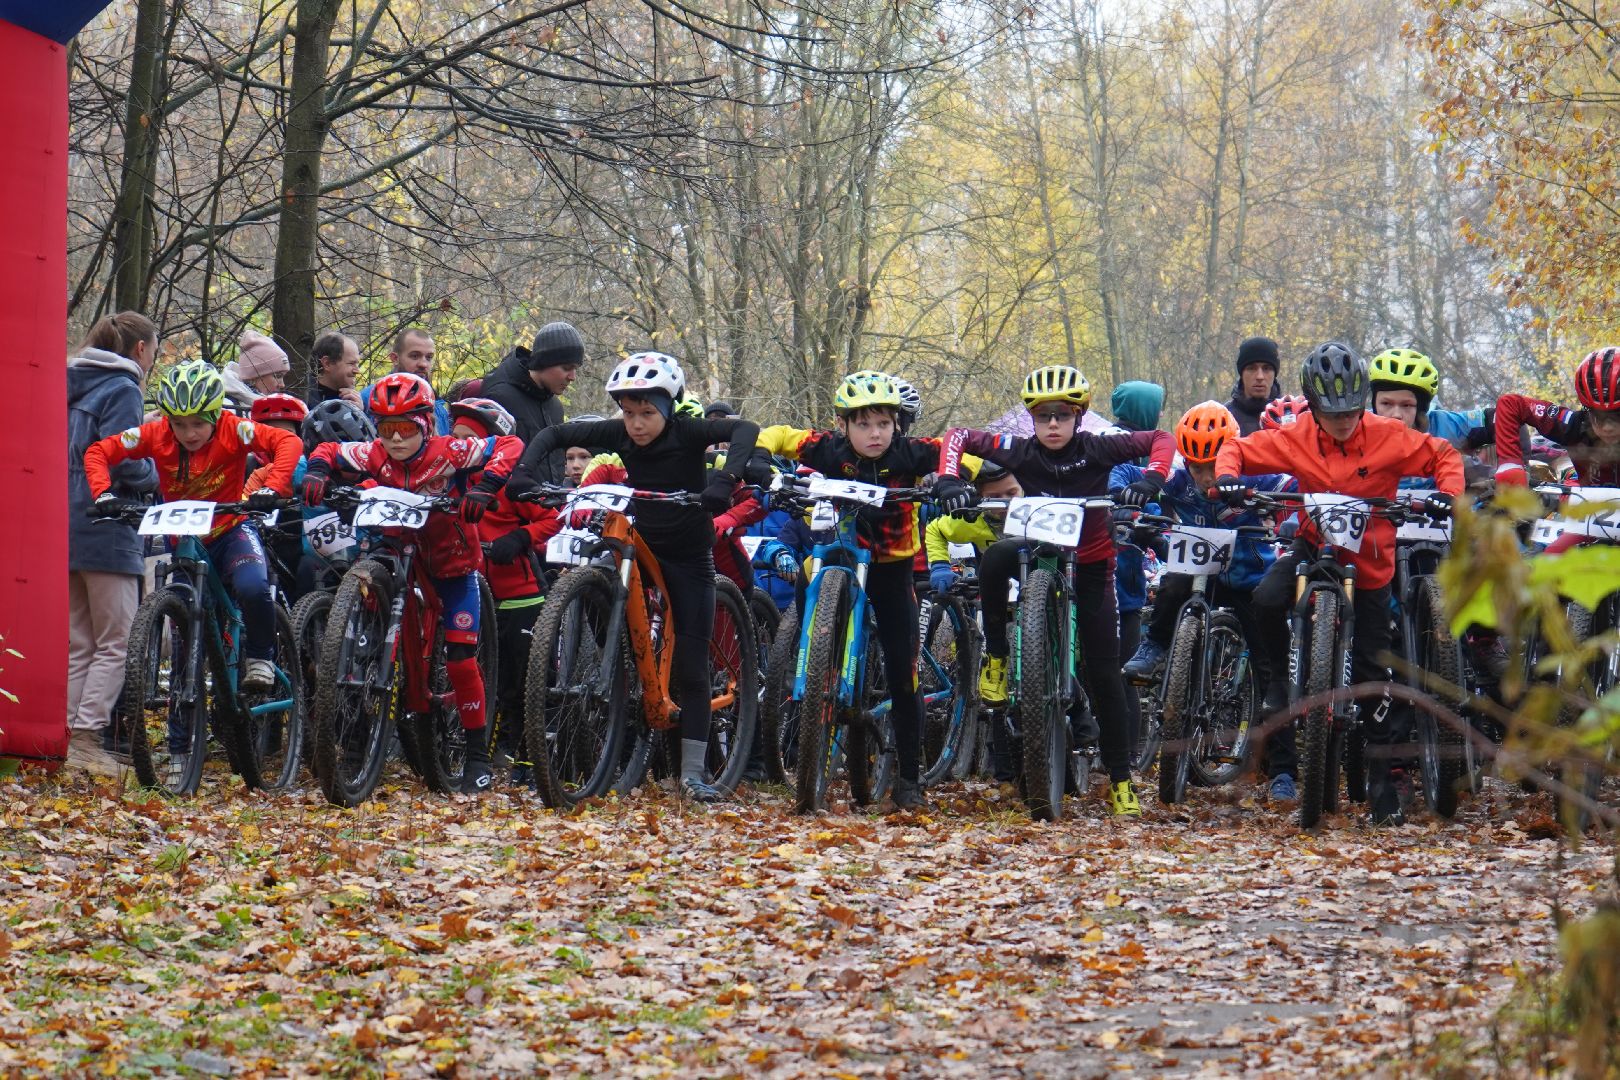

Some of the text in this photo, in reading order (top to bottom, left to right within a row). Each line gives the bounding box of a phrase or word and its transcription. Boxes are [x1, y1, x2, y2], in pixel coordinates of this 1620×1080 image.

[147, 507, 210, 527] 155
[1009, 503, 1078, 535] 428
[1172, 539, 1232, 566] 194
